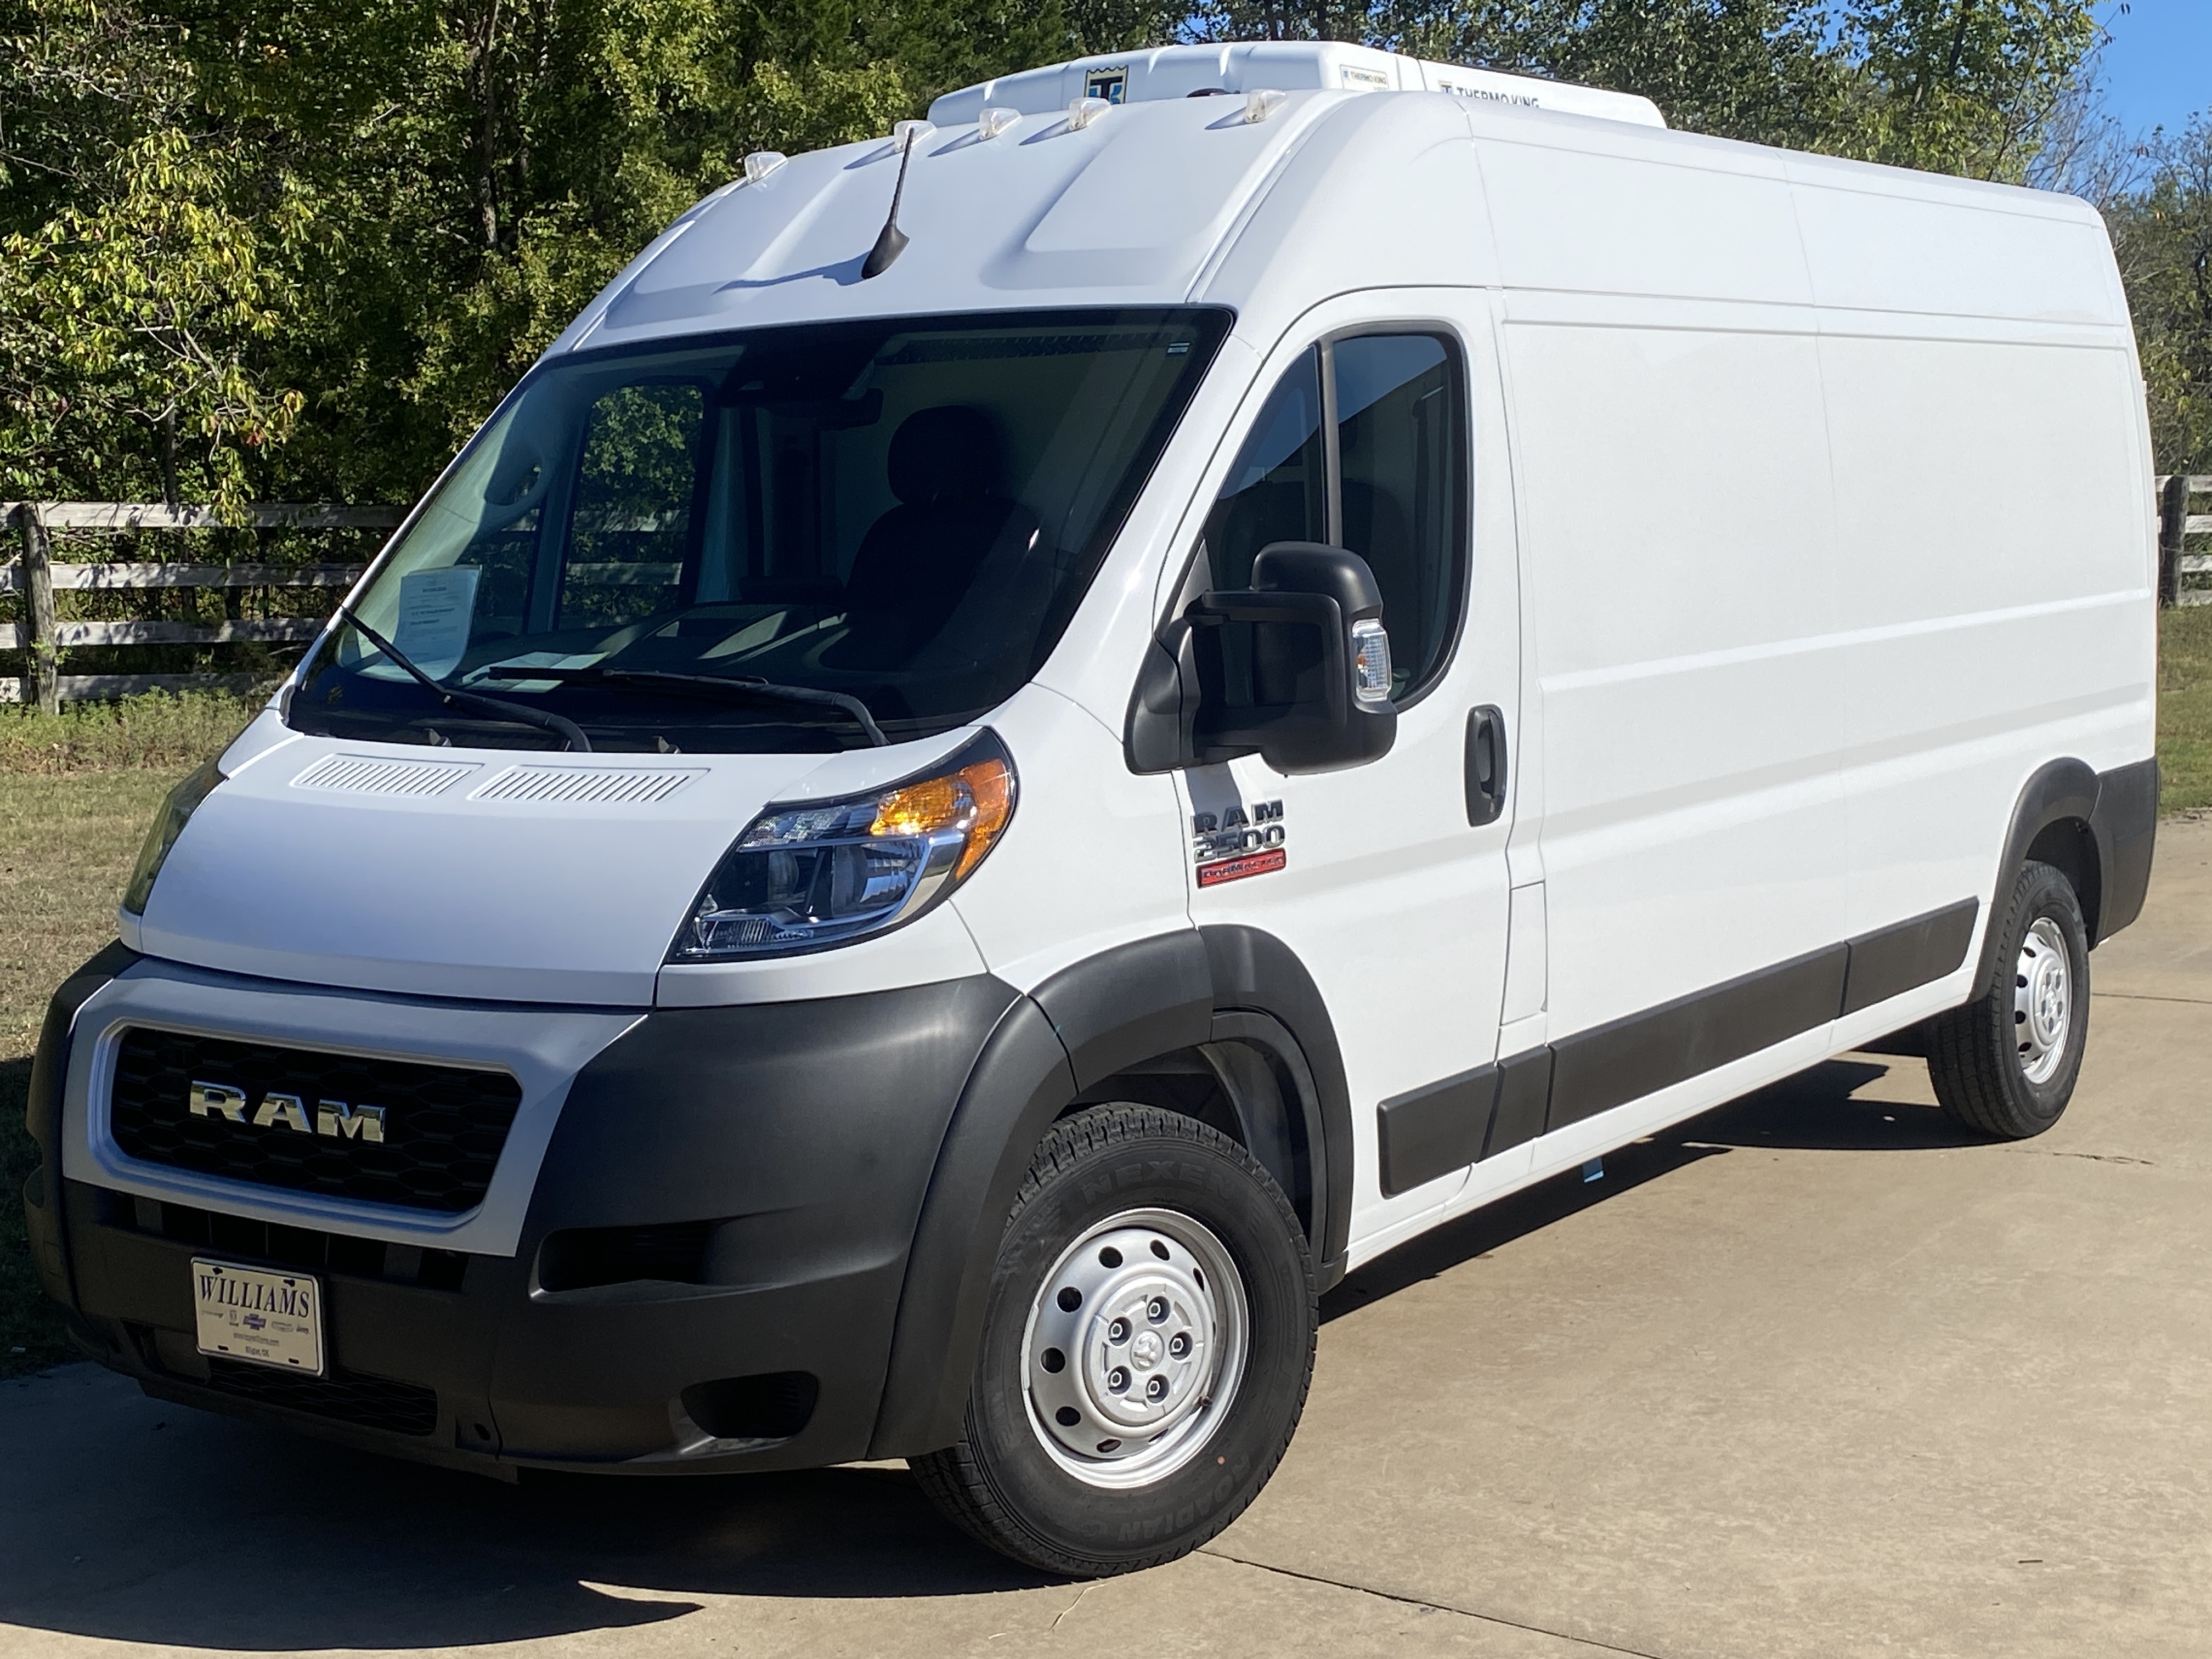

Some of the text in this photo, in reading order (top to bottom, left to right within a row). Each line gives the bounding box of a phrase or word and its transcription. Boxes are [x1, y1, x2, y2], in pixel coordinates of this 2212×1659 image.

[1190, 799, 1284, 838] RAM
[1193, 824, 1285, 864] 2500
[190, 1080, 386, 1143] RAM
[1080, 1160, 1232, 1205] NEXEN
[199, 1274, 310, 1318] WILLIAMS
